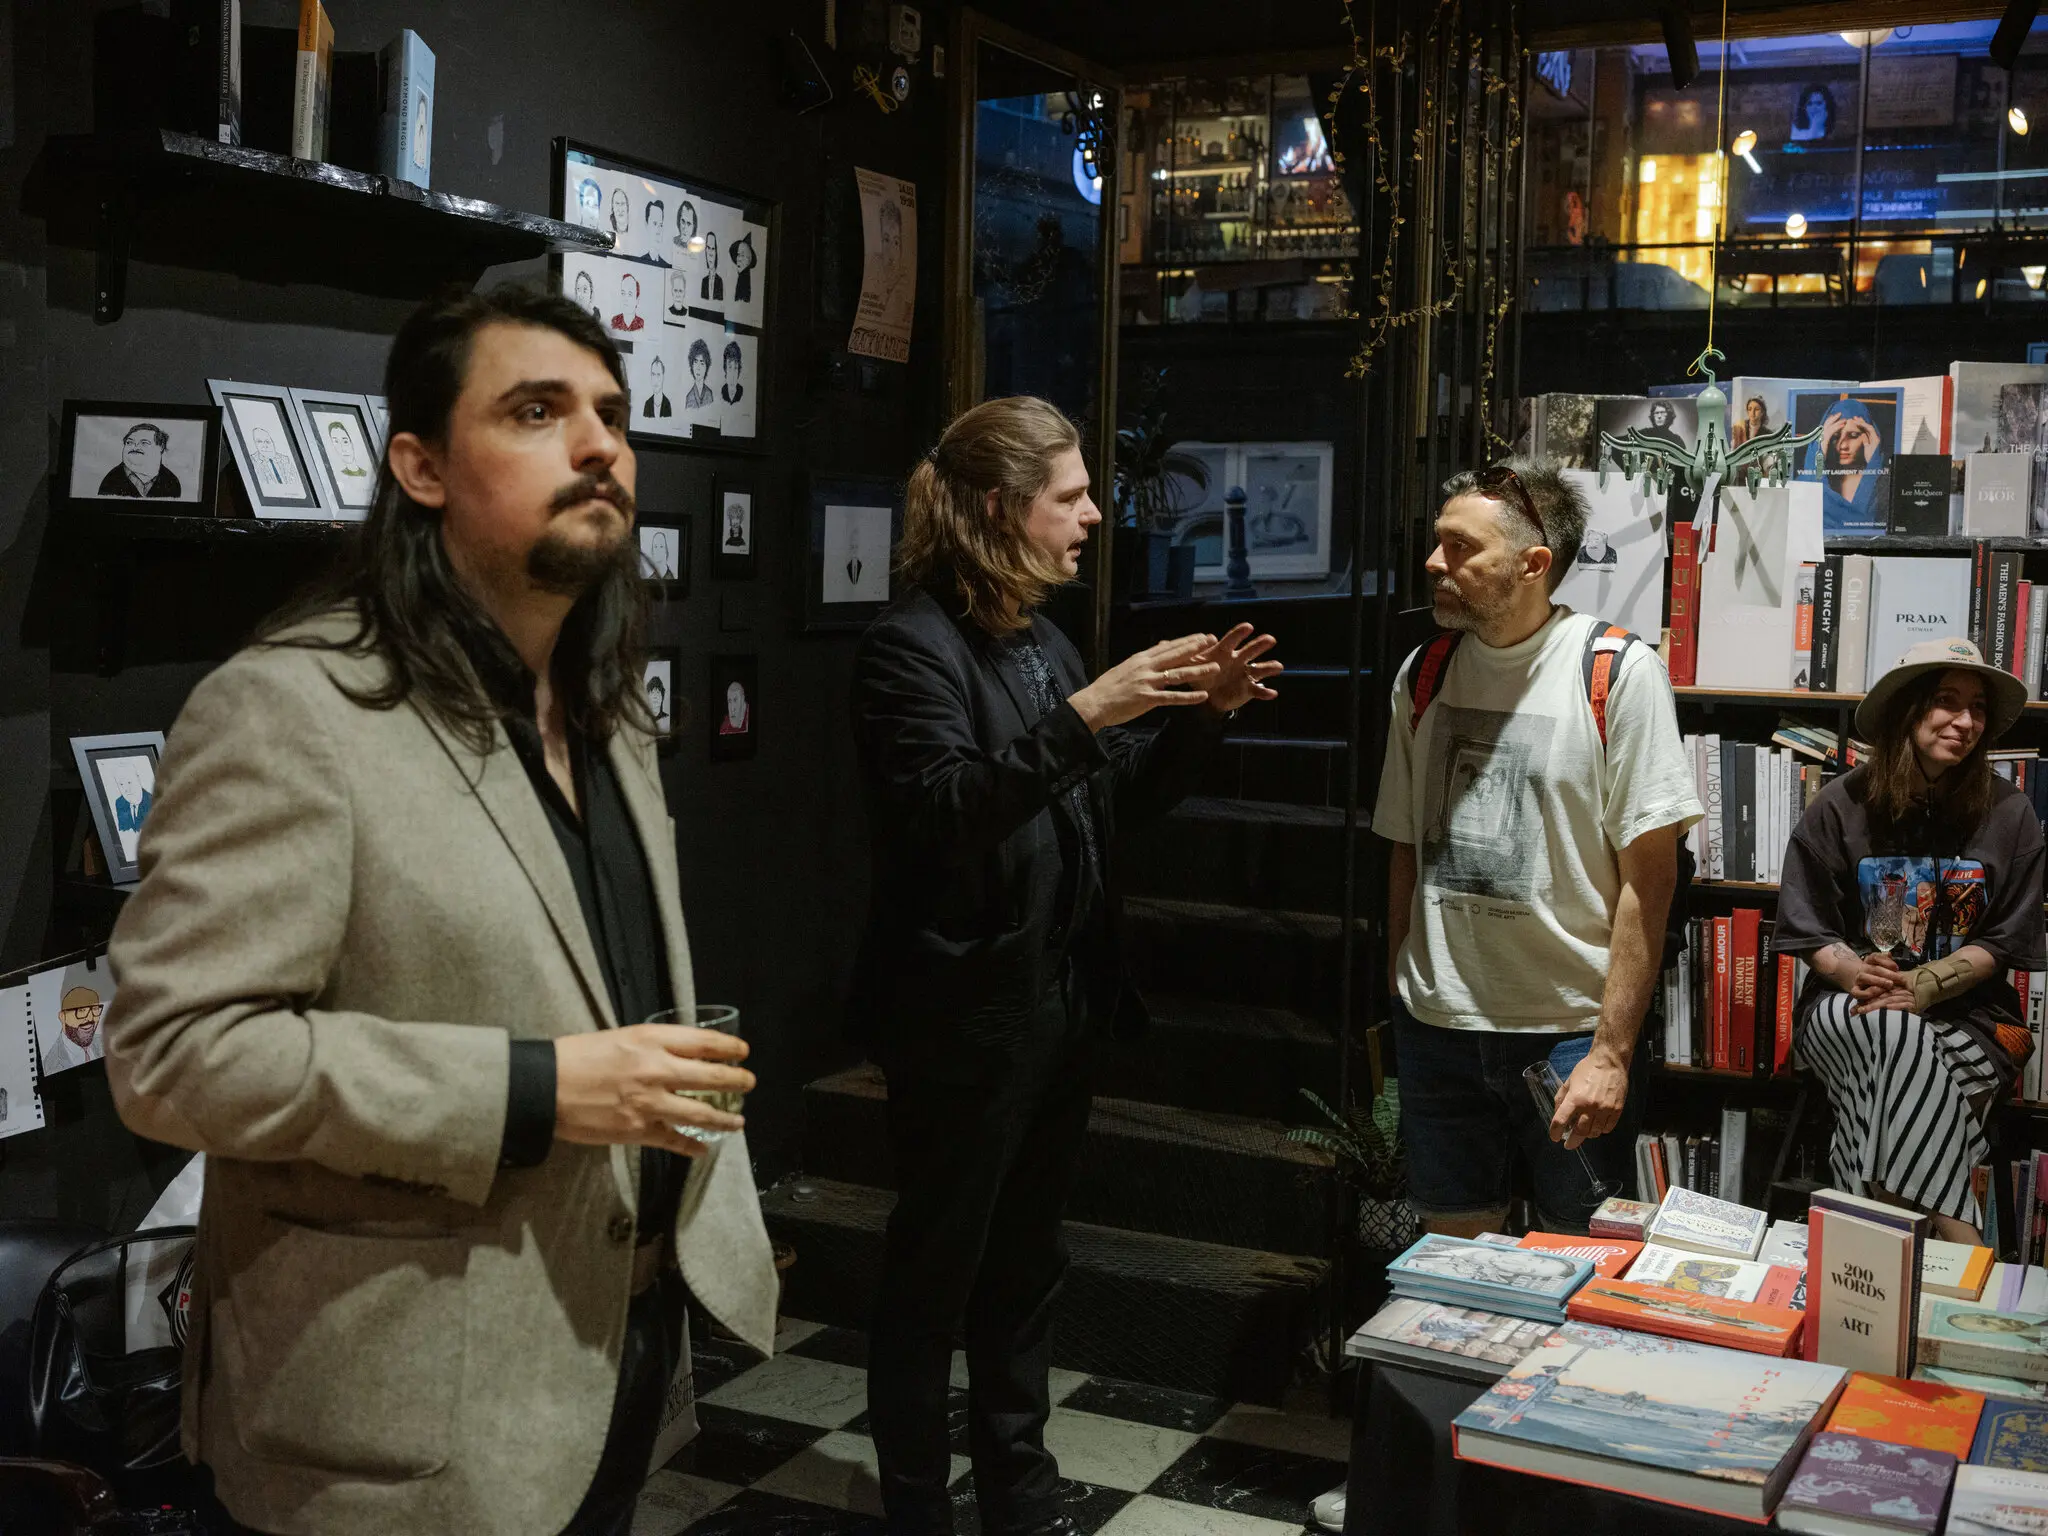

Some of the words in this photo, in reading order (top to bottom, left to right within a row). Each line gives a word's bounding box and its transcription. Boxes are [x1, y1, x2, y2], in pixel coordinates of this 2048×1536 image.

[401, 76, 409, 117] RAYMOND
[400, 121, 408, 151] BRIGGS
[2009, 444, 2030, 454] THE
[1831, 468, 1857, 476] LAURENT
[1913, 489, 1943, 497] McQueen
[1978, 490, 2015, 504] DIOR
[2000, 562, 2009, 582] THE
[1822, 568, 1834, 634] GIVENCHY
[1846, 576, 1864, 622] Chloé
[1998, 582, 2008, 611] MEN'S
[1896, 613, 1948, 624] PRADA
[1995, 612, 2006, 651] FASHION
[1820, 643, 1828, 669] CATWALK
[1705, 743, 1719, 770] ALL
[1706, 772, 1722, 826] ABOUT
[1708, 826, 1723, 863] YVES
[1954, 870, 1974, 879] LIVE
[1717, 924, 1726, 974] GLAMOUR
[1762, 935, 1770, 965] CHANEL
[1735, 956, 1745, 1005] INDONESIA
[1745, 955, 1755, 995] TEXTILES
[1779, 965, 1790, 1006] DONOVAN
[1744, 995, 1754, 1008] OF
[2029, 997, 2042, 1034] TIE
[1779, 1007, 1788, 1042] FASHION
[1831, 1272, 1886, 1301] WORDS
[1844, 1262, 1874, 1283] 200
[1840, 1315, 1873, 1337] ART
[1706, 1369, 1781, 1448] HIROSHIGE
